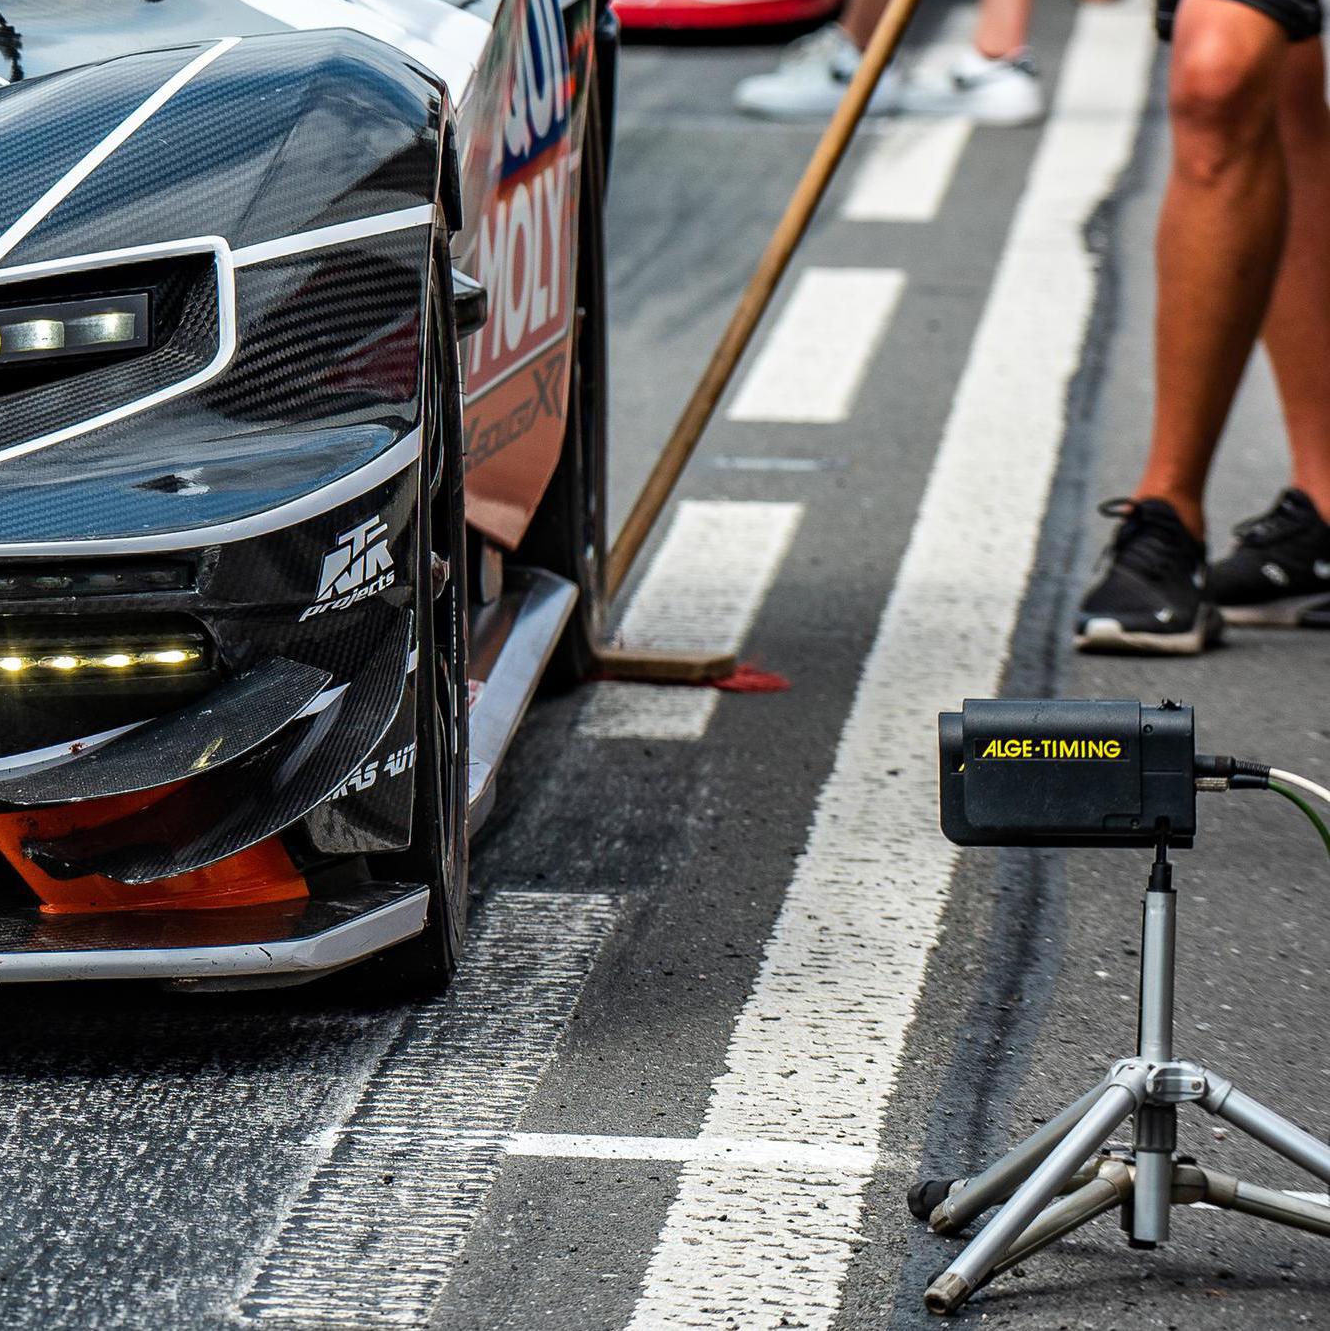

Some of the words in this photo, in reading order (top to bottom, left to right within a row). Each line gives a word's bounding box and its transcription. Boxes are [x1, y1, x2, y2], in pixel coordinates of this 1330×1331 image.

[470, 150, 580, 375] MOLY
[299, 570, 395, 622] projects
[982, 739, 1121, 759] ALGE-TIMING
